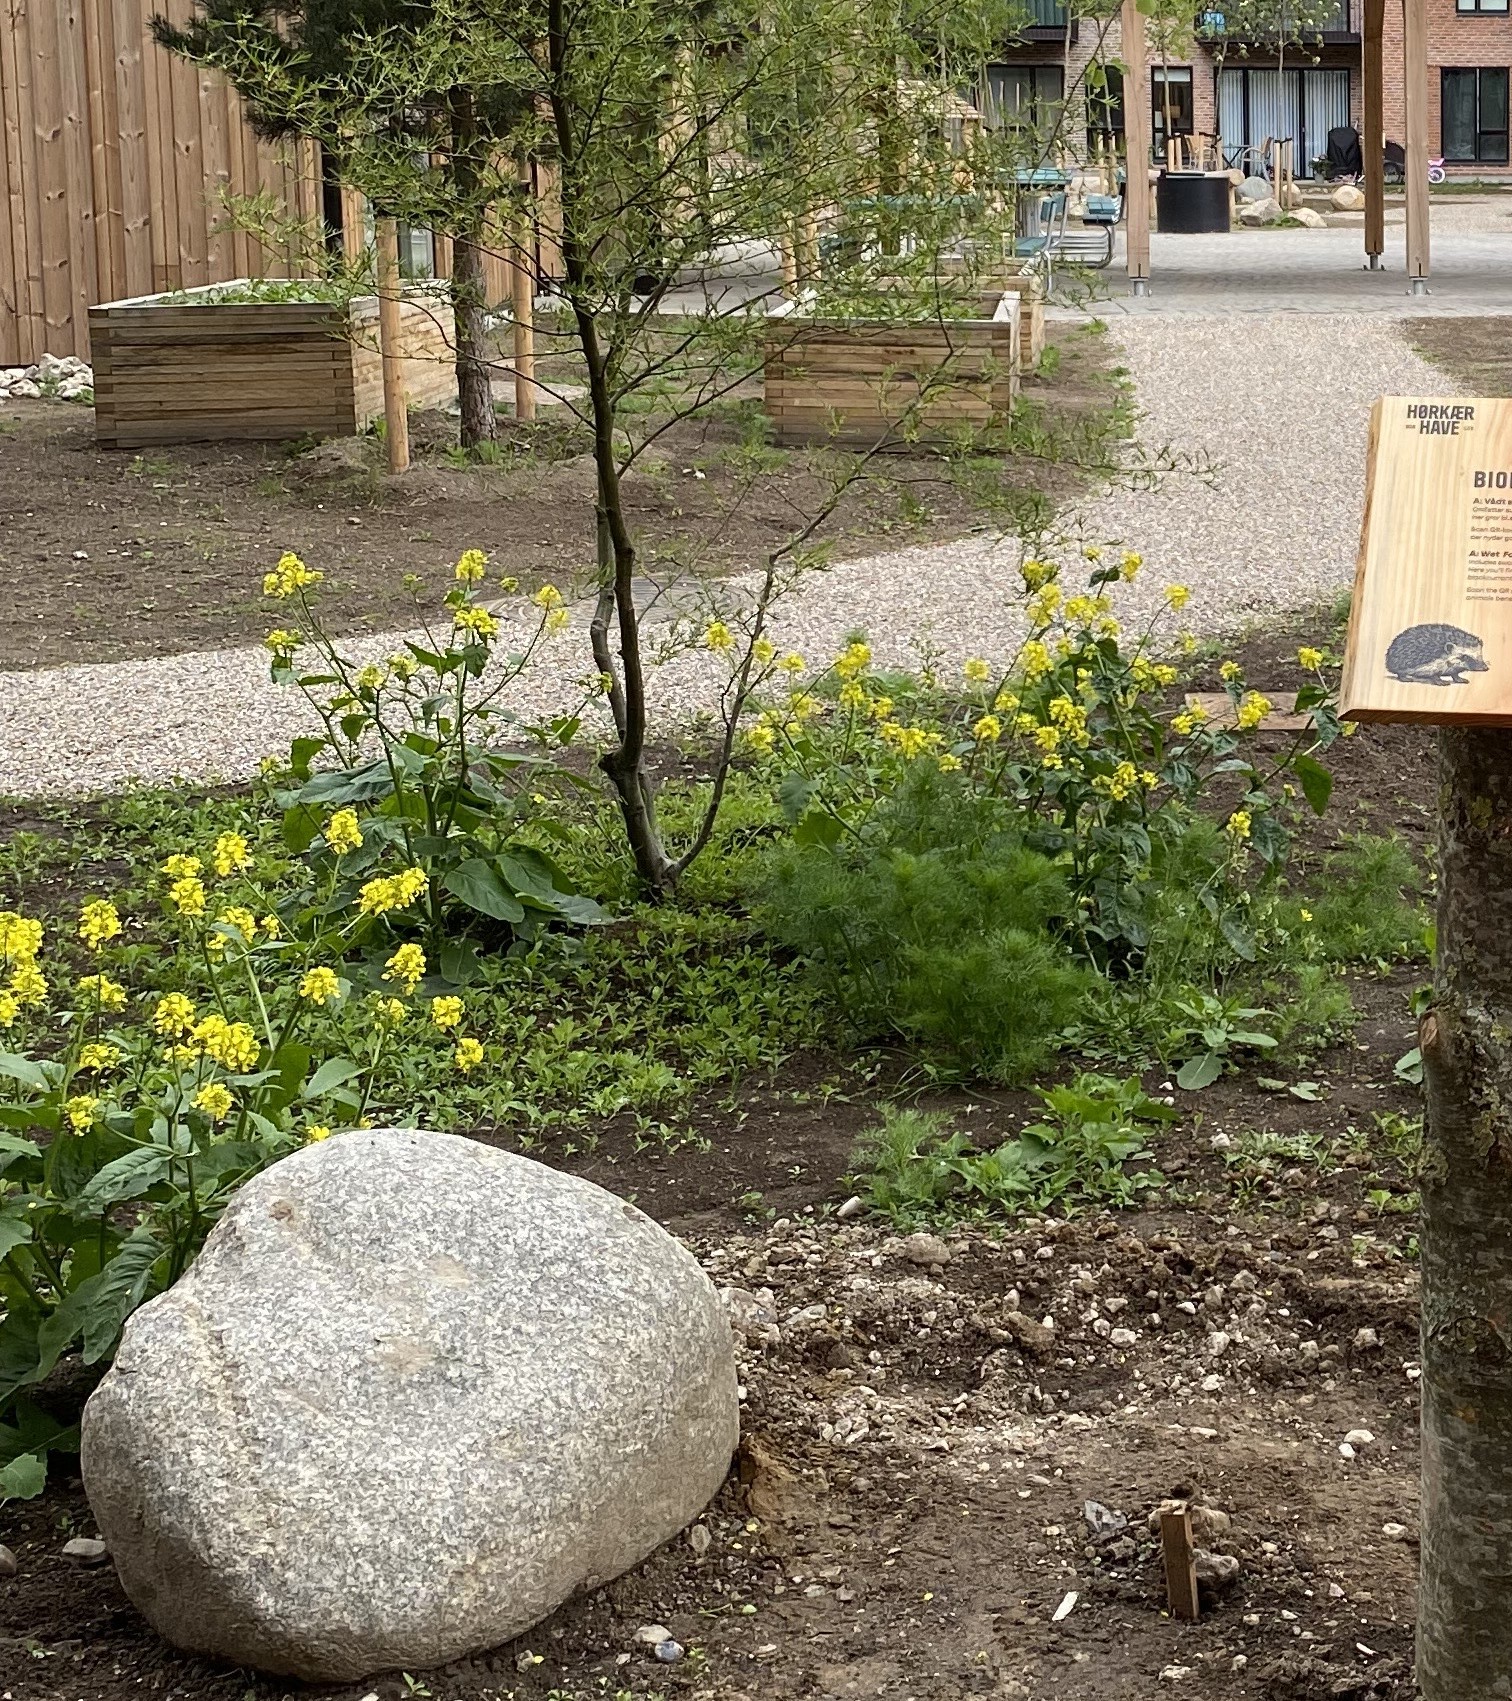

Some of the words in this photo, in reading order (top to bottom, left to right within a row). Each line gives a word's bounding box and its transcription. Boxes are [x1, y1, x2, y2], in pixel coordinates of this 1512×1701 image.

[1407, 404, 1475, 421] HØRKÆR
[1419, 420, 1460, 436] HAVE
[1472, 497, 1483, 505] A:
[1484, 497, 1507, 505] Vådt
[1468, 549, 1480, 557] A:
[1480, 550, 1501, 558] Wet
